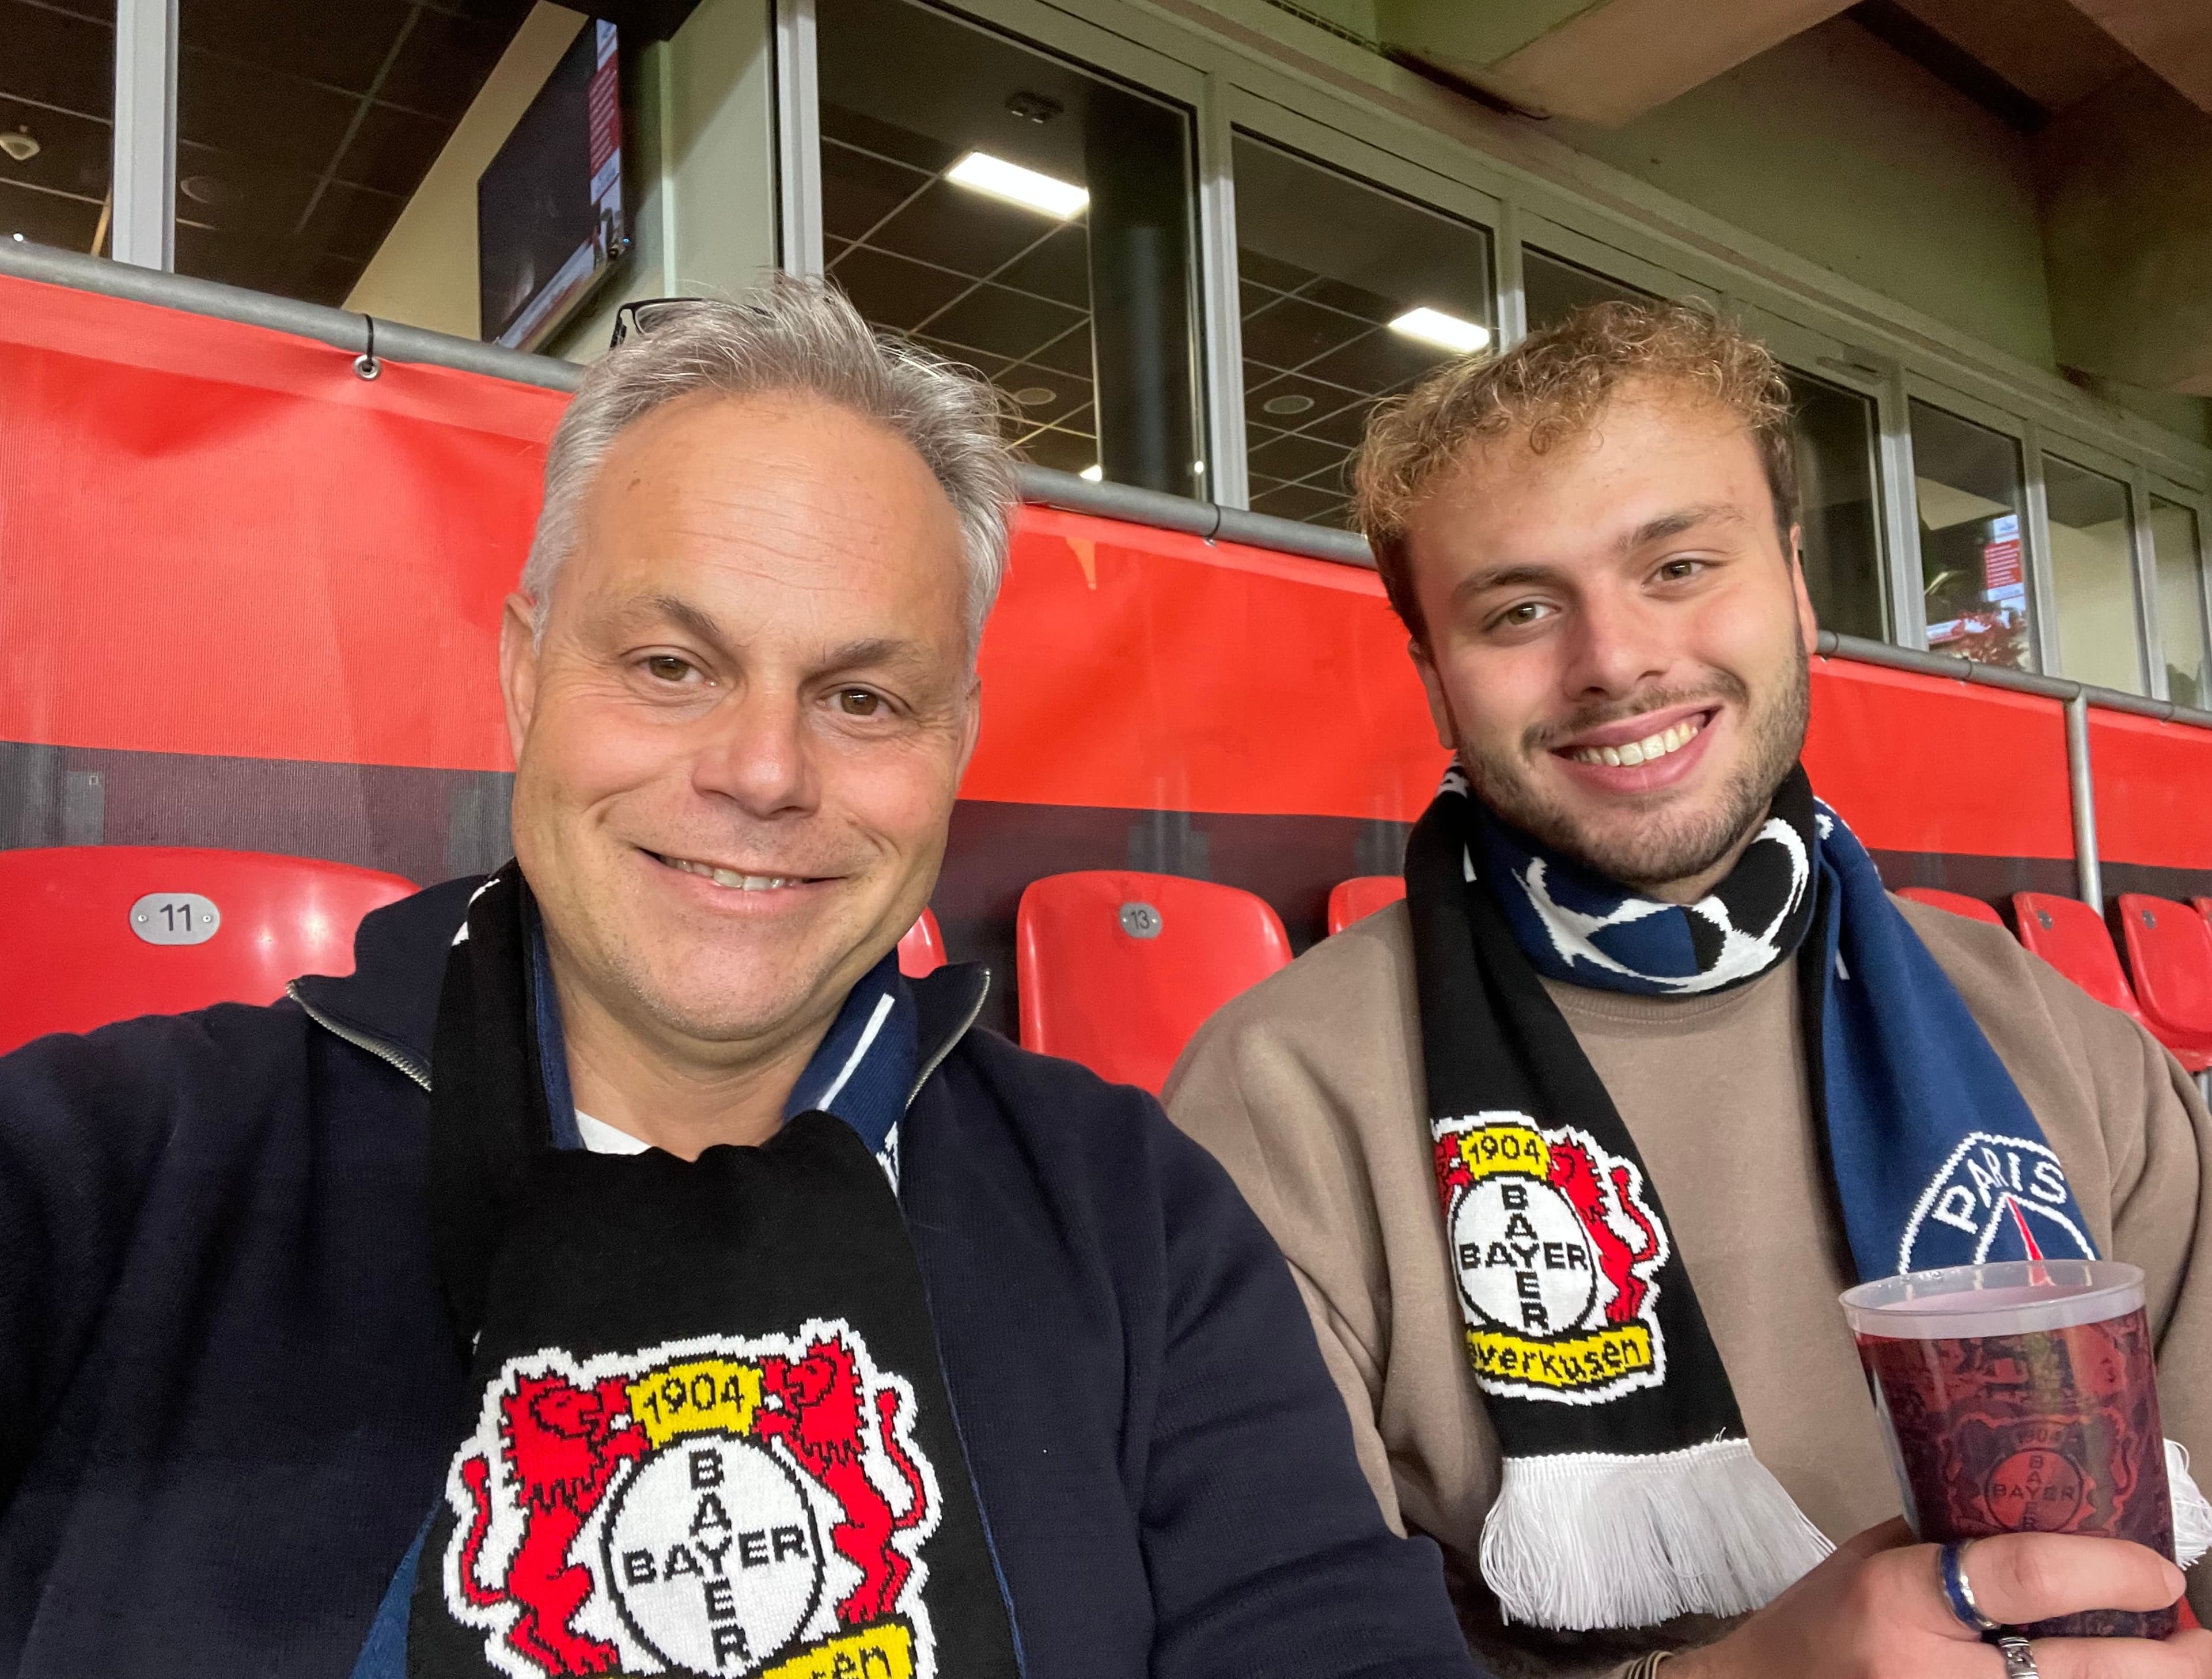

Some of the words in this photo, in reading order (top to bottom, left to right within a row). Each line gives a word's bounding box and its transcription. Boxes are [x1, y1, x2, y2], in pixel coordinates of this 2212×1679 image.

[160, 904, 191, 931] 11
[1131, 909, 1150, 930] 13
[1469, 1134, 1541, 1166] 1904
[1931, 1147, 2067, 1234] PARIS
[1459, 1241, 1589, 1271] BAYER
[1501, 1184, 1550, 1328] BAYER
[644, 1373, 746, 1419] 1904
[1993, 1483, 2074, 1500] BAYER
[623, 1525, 808, 1586] BAYER
[691, 1450, 752, 1668] BAYER
